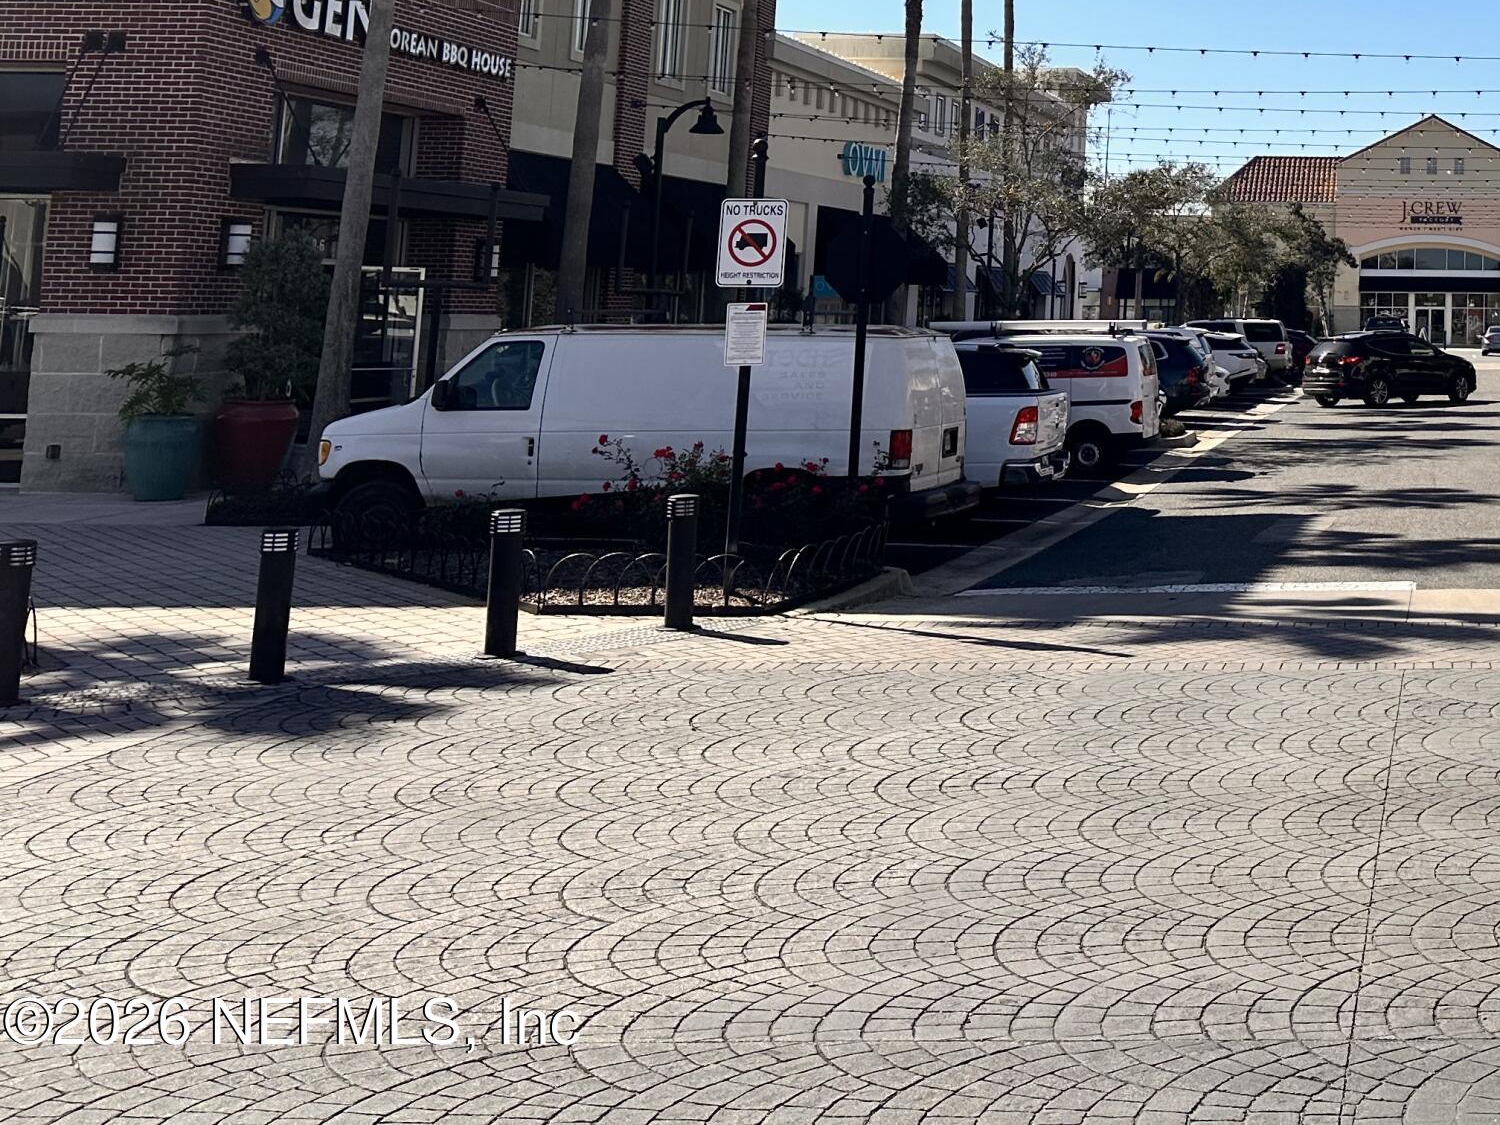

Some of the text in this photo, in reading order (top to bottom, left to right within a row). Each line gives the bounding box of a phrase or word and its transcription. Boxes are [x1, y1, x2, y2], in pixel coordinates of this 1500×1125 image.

[390, 28, 512, 78] OREAN BBQ HOUSE
[726, 204, 784, 216] NO TRUCKS
